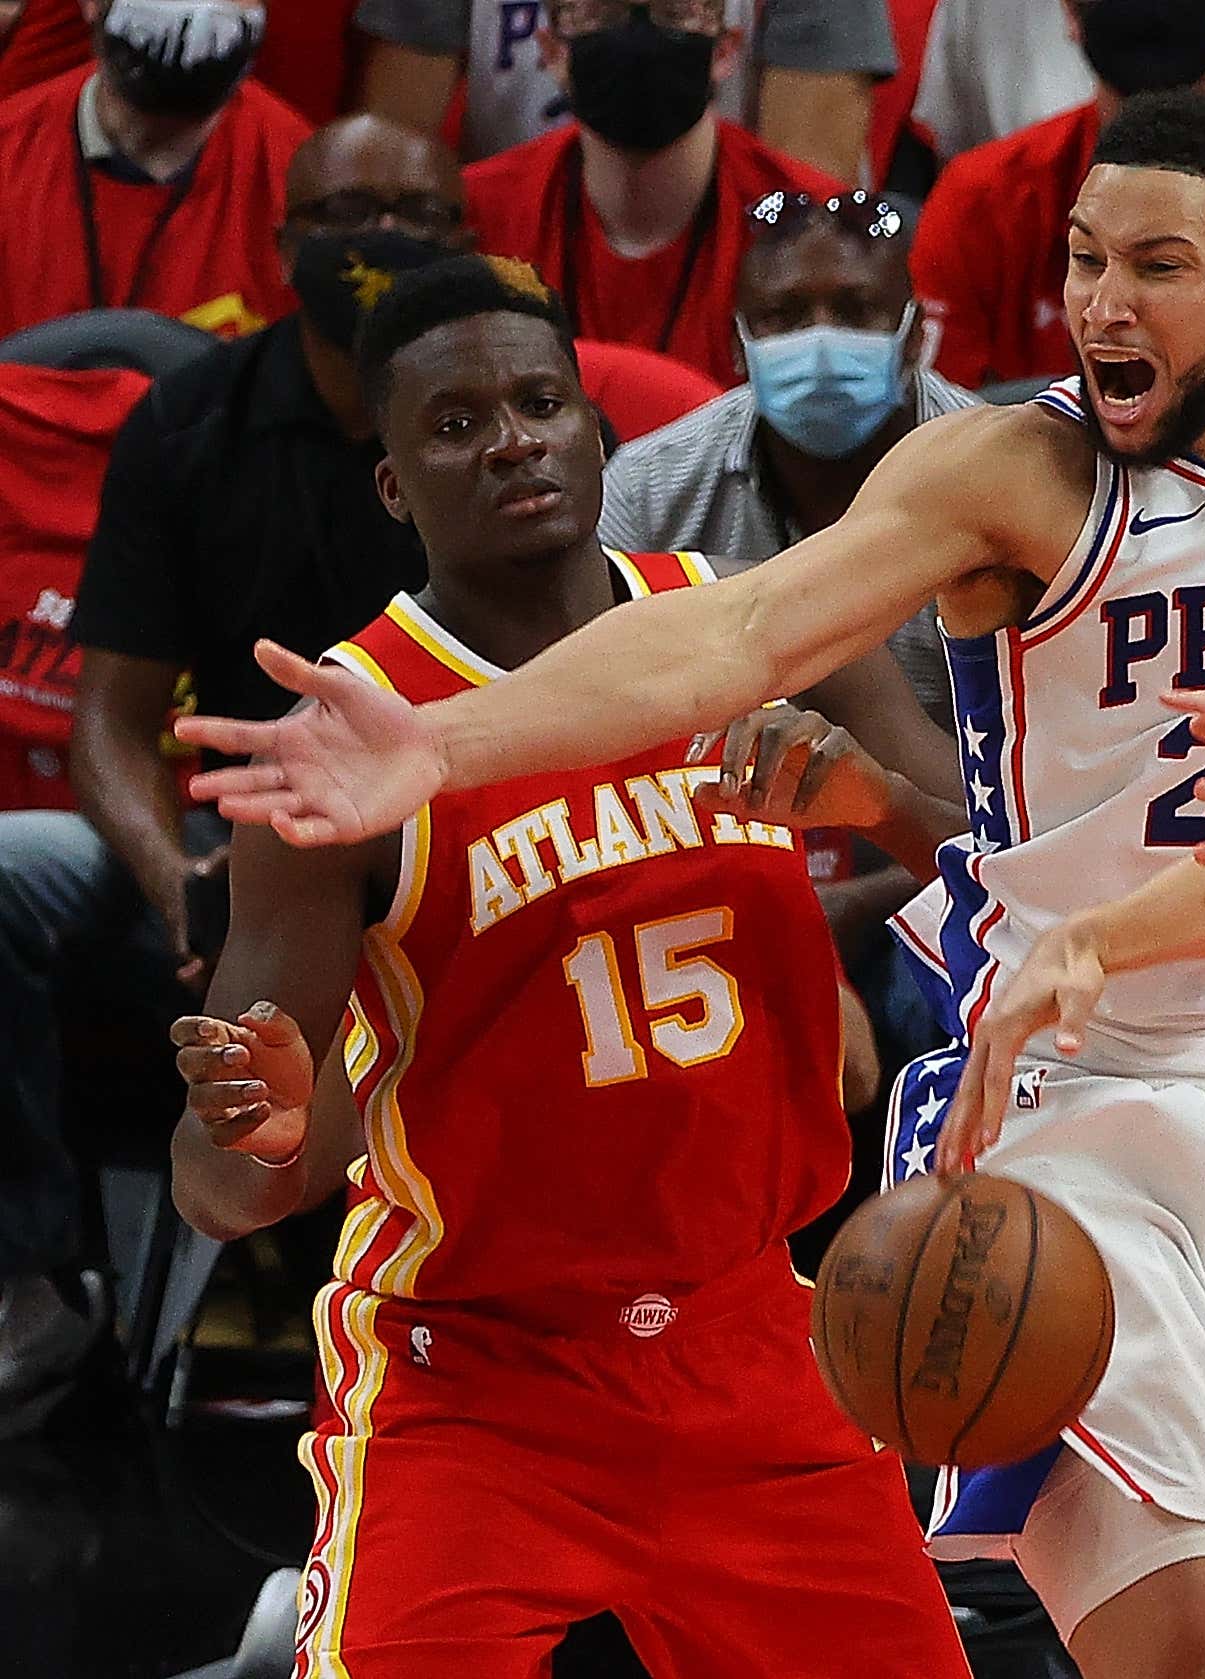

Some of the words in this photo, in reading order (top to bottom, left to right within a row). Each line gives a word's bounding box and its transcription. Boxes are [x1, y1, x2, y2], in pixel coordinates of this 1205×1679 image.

[467, 765, 795, 937] ATLAN
[562, 906, 744, 1087] 15
[618, 1306, 679, 1326] HAWKS
